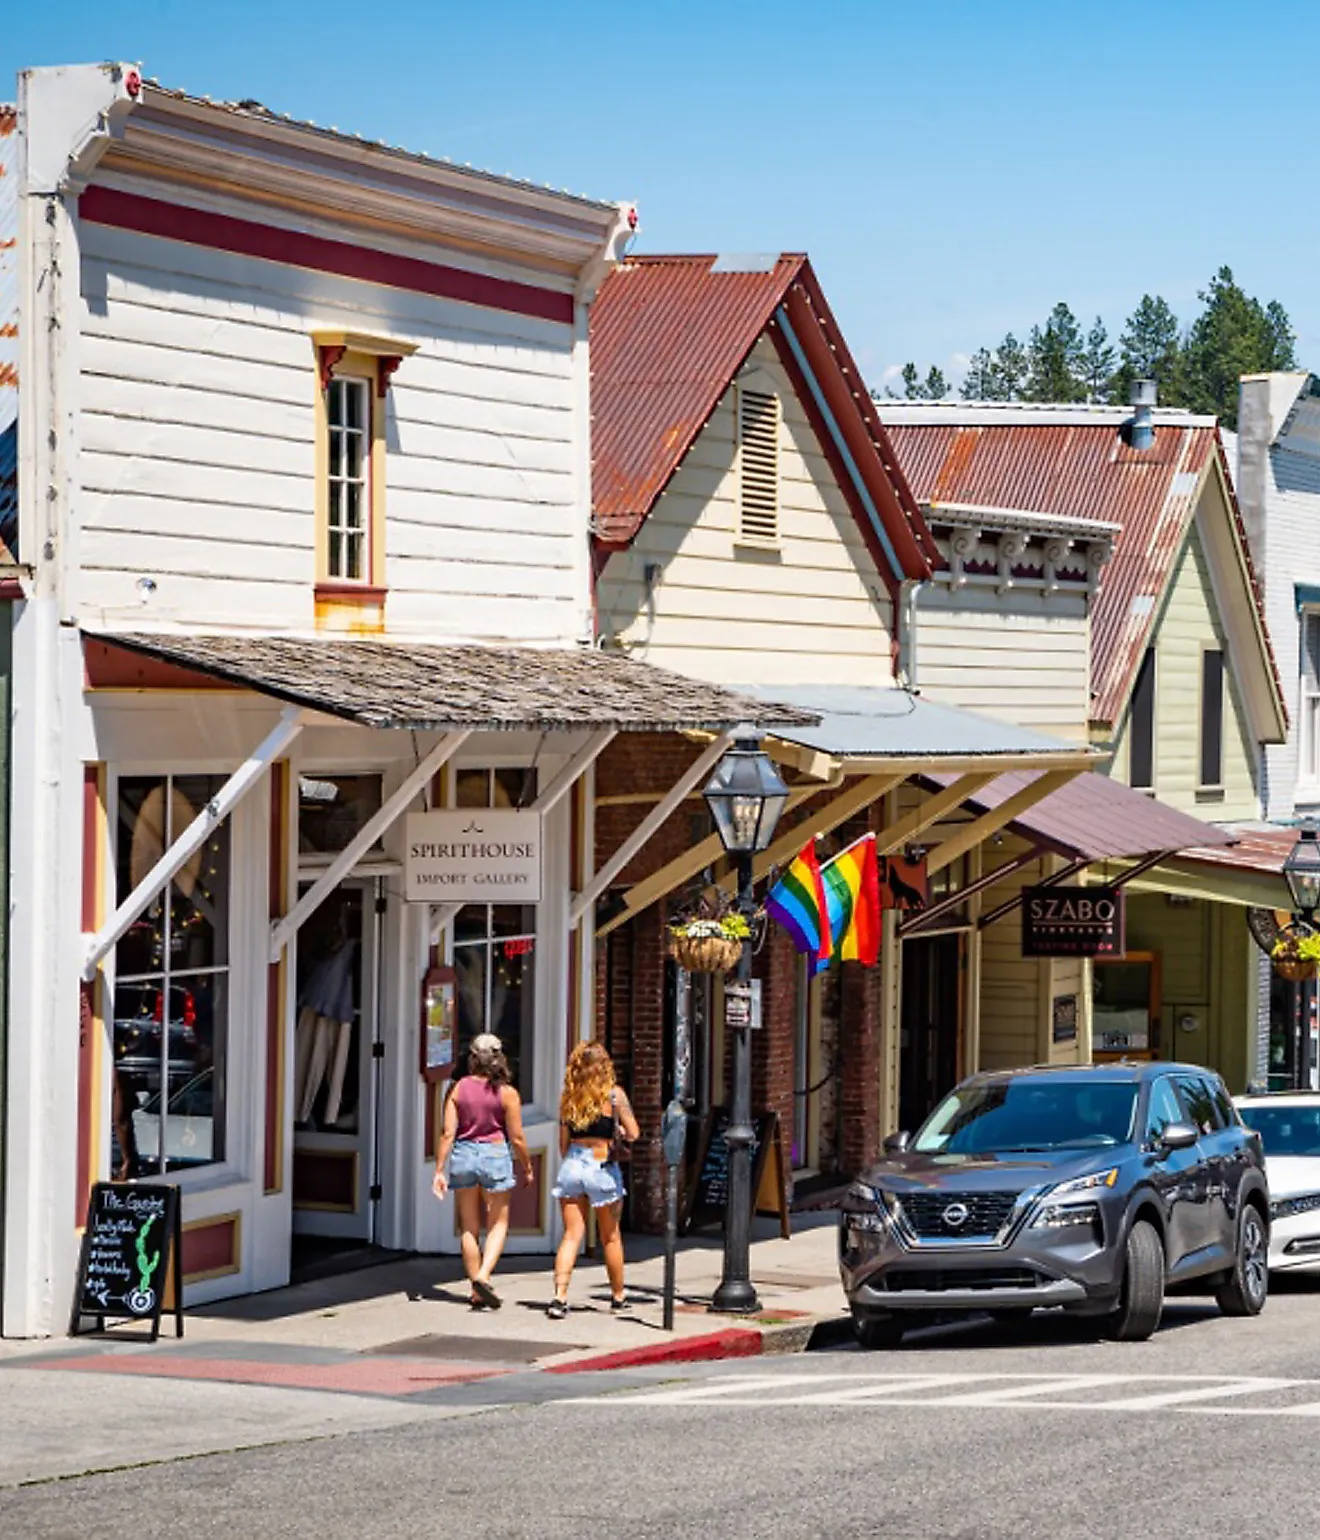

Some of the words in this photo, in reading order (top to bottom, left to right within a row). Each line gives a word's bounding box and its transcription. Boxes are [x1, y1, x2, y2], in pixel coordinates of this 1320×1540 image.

[410, 843, 535, 858] SPIRITHOUSE
[416, 873, 467, 885] IMPORT
[473, 873, 529, 885] GALLERY
[1030, 899, 1115, 921] SZABO
